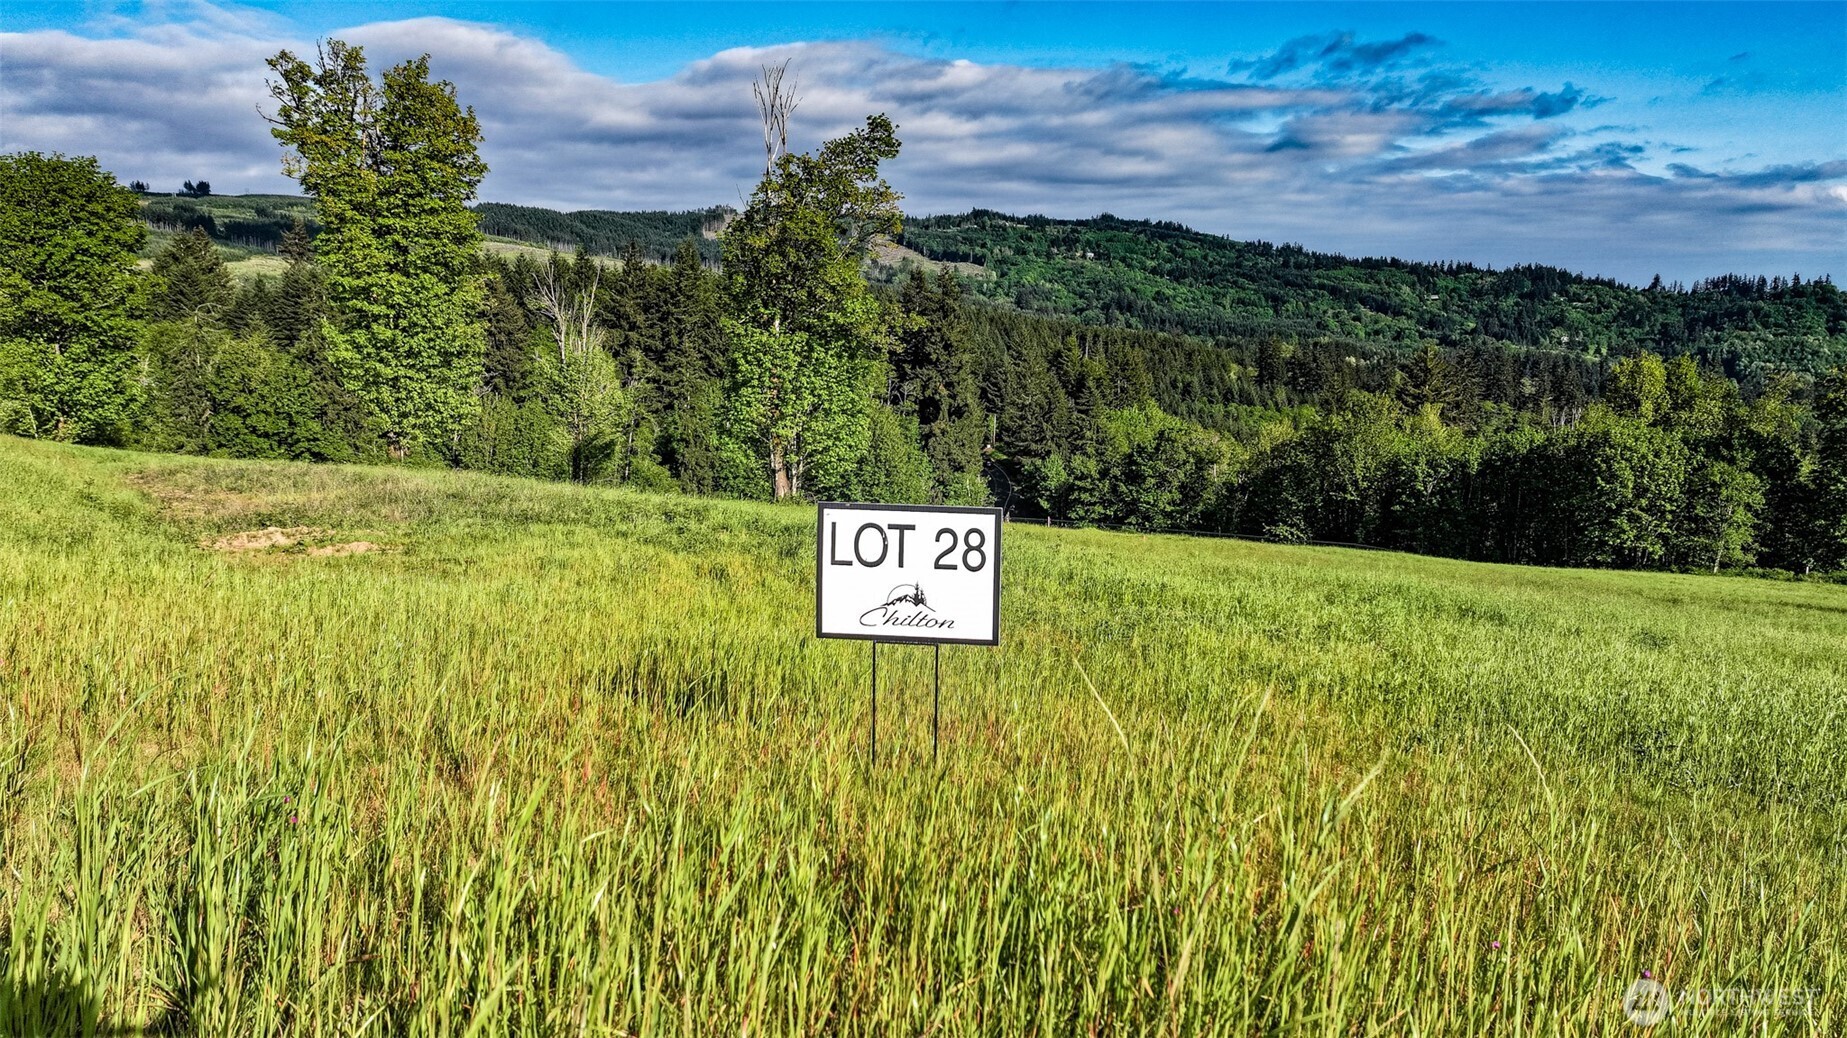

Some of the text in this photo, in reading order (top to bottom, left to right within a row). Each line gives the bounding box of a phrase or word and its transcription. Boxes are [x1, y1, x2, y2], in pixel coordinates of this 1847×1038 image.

[830, 521, 987, 572] LOT 28
[859, 606, 955, 629] Chilton
